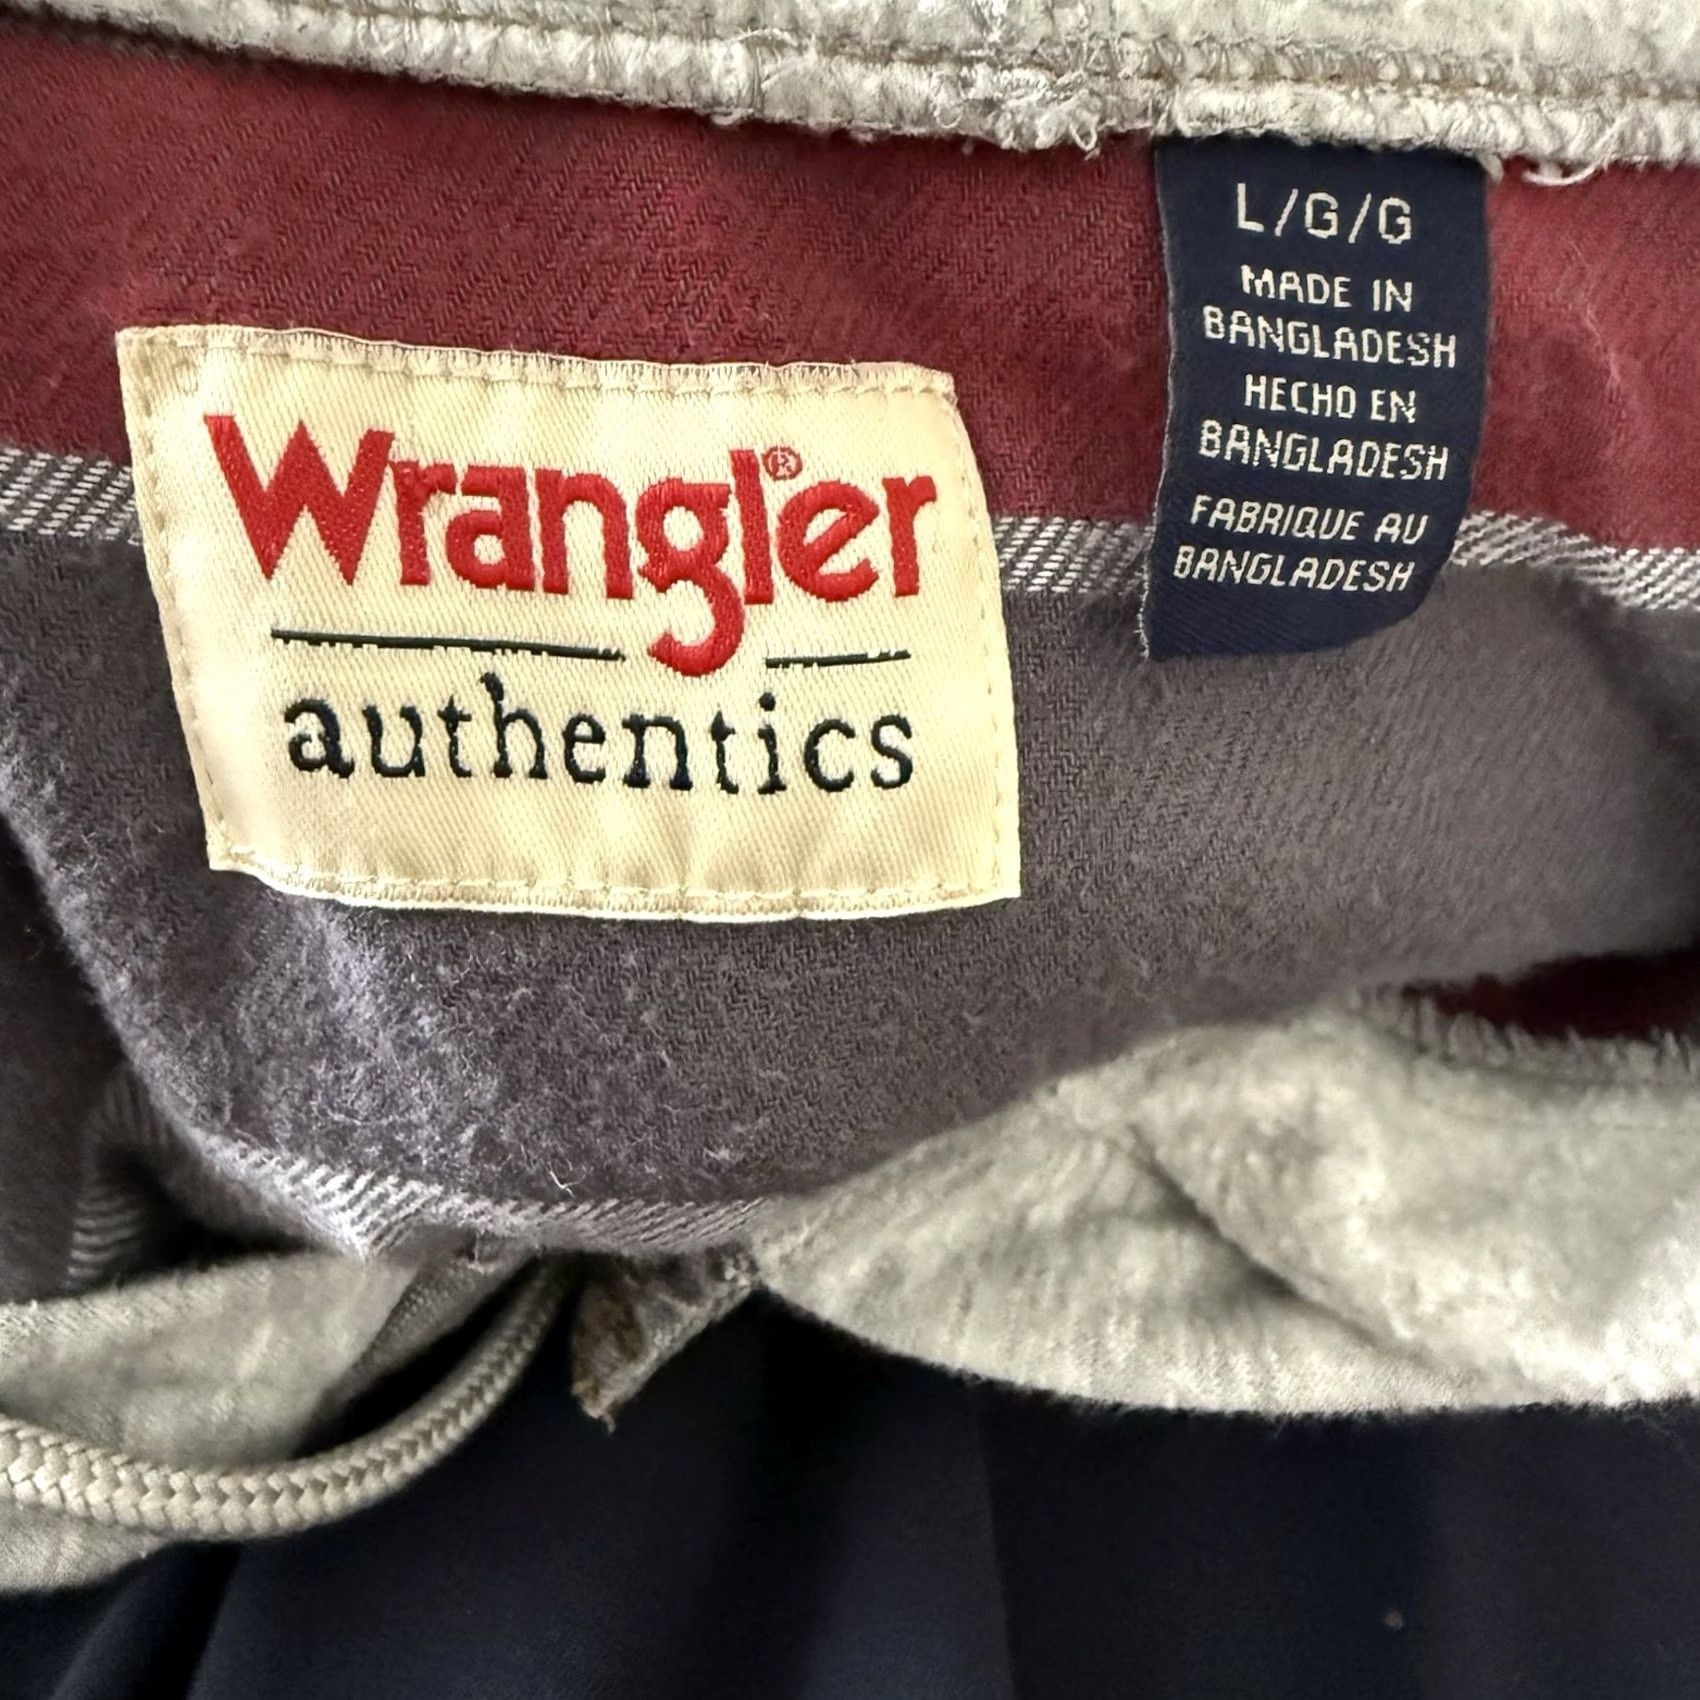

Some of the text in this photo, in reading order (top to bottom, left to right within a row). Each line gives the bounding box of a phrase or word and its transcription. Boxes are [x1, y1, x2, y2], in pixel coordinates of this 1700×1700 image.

[1238, 183, 1412, 245] L/G/G
[1241, 265, 1412, 312] MADE IN
[1203, 305, 1456, 368] BANGLADESH
[1244, 374, 1416, 423] HECHO EN
[1199, 419, 1448, 480] BANGLADESH
[206, 416, 935, 676] Wrangler
[1191, 495, 1428, 544] FABRIQUE AU
[1174, 545, 1415, 592] BANGLADESH
[285, 673, 913, 794] authentics
